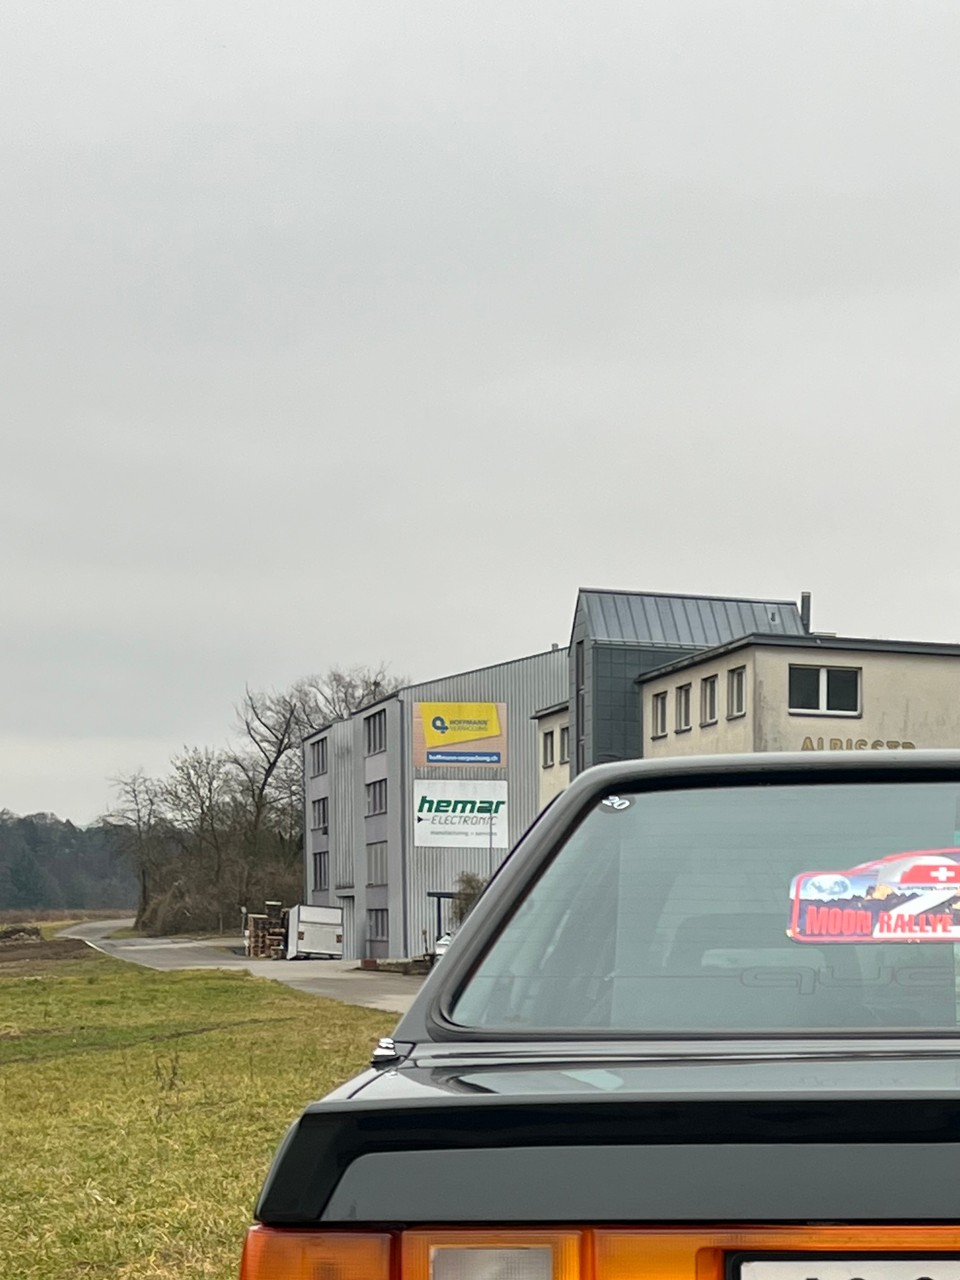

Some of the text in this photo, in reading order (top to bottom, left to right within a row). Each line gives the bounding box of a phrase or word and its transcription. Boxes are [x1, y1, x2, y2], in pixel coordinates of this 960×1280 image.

[417, 796, 506, 813] hemar
[431, 816, 497, 826] ELECTRONIC
[806, 906, 872, 935] MOON
[879, 911, 953, 934] RALLYE
